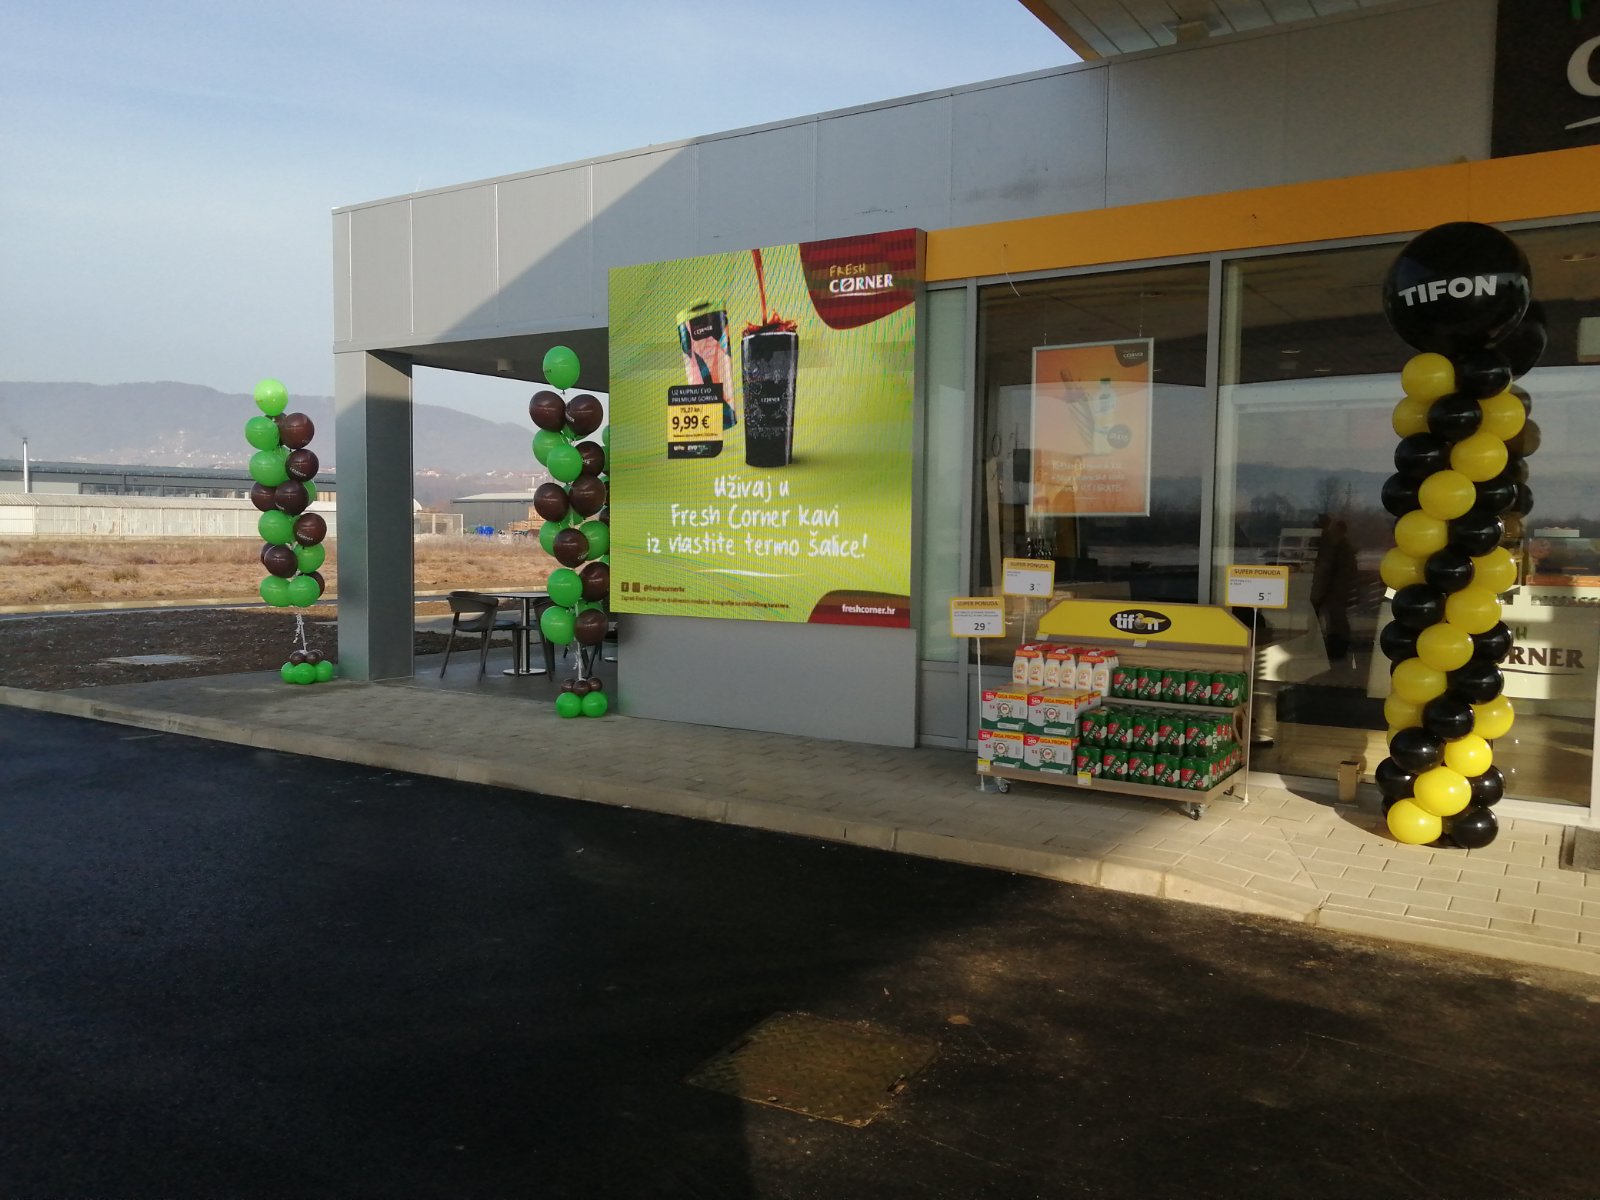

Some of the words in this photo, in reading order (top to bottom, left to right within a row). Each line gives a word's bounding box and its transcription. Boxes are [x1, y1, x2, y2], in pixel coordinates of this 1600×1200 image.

[829, 262, 866, 277] FRESH
[829, 273, 894, 293] CORNER
[1398, 275, 1498, 307] TIFON
[672, 415, 699, 432] 9,99
[701, 415, 710, 429] €
[714, 474, 773, 503] Uživaj
[779, 480, 790, 497] u
[671, 503, 721, 527] Fresh
[728, 503, 791, 529] Corner
[798, 504, 839, 527] kavi
[647, 532, 662, 554] iz
[668, 532, 735, 555] vlastite
[744, 533, 800, 556] termo
[808, 530, 868, 559] šalice!
[1029, 583, 1035, 591] 3
[1258, 592, 1265, 601] 5
[842, 604, 896, 614] freshcorner.hr
[974, 622, 986, 631] 29
[1507, 646, 1585, 669] RNER
